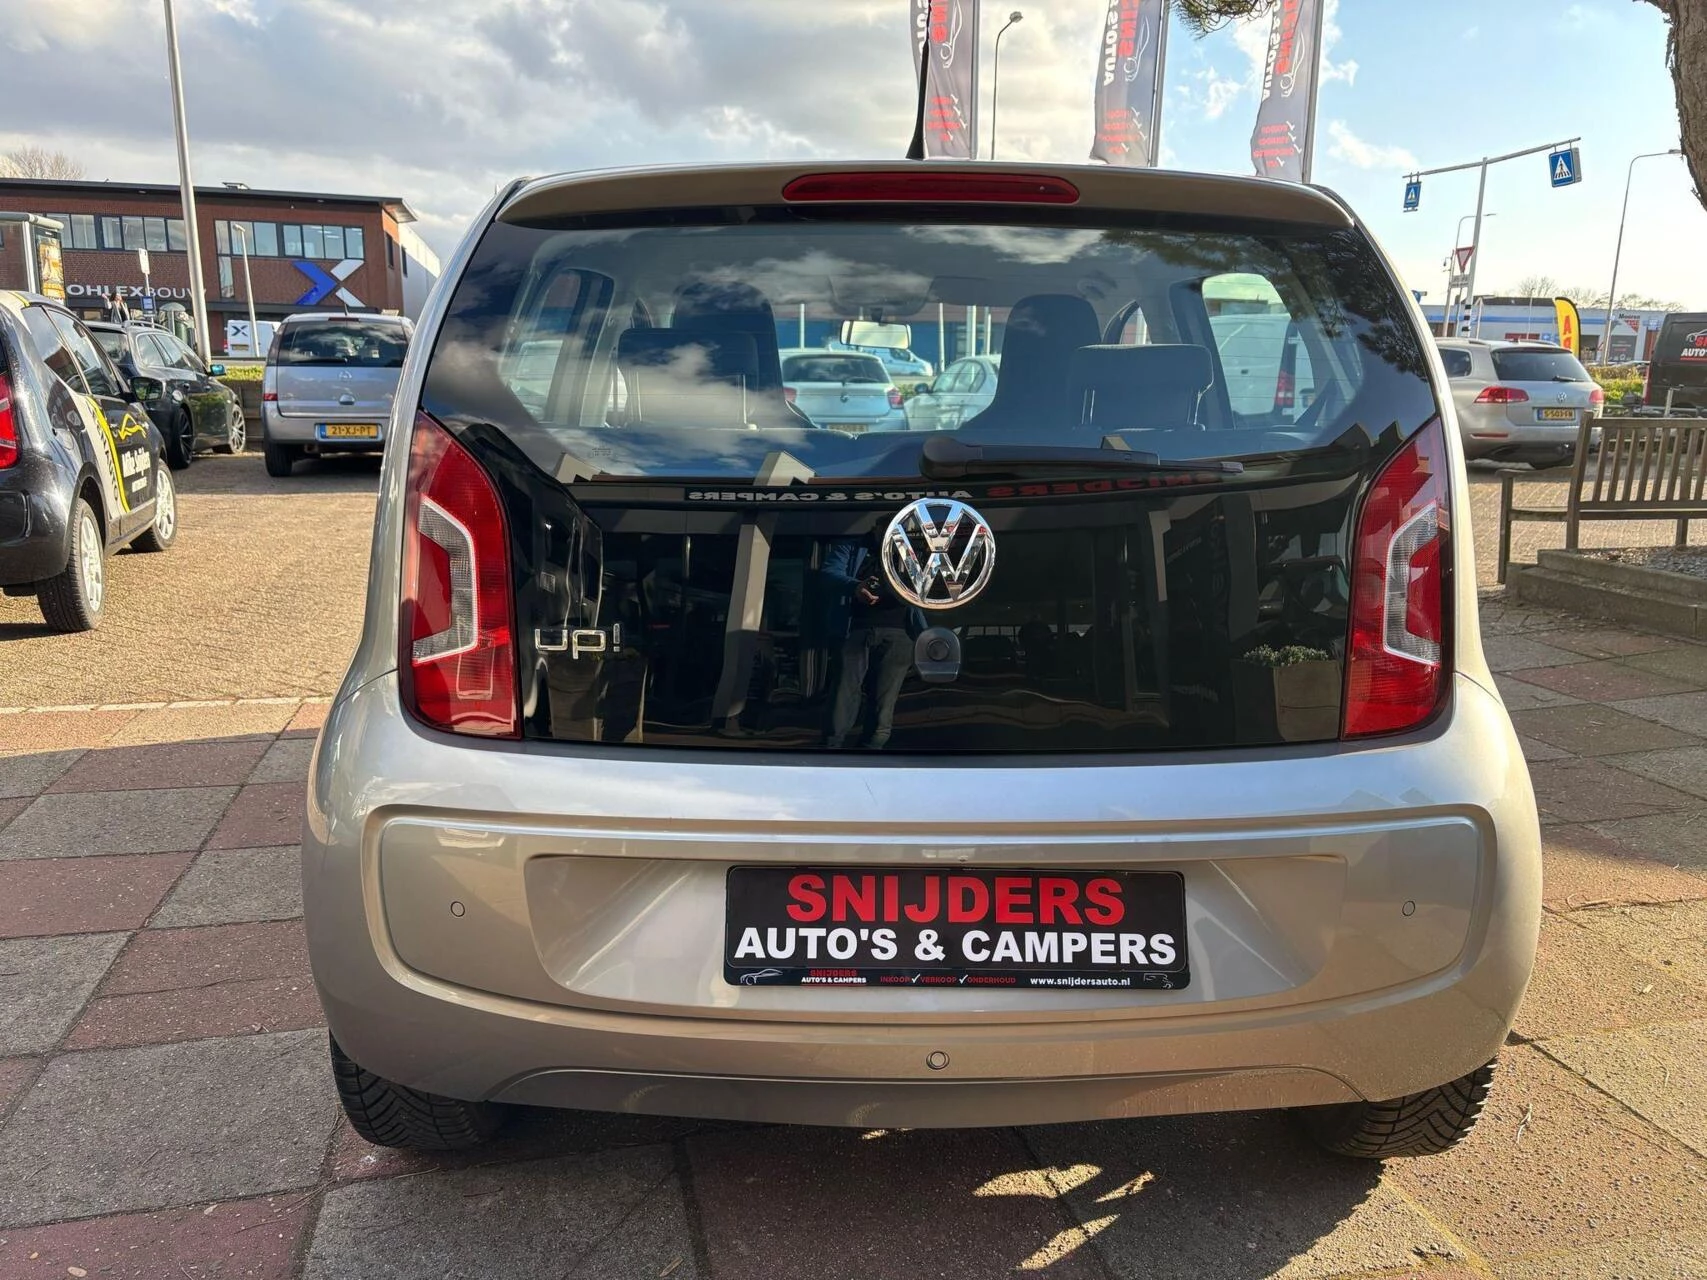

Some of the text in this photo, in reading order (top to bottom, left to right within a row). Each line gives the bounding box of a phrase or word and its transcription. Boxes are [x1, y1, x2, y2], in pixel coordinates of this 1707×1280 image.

[534, 623, 620, 660] up!
[786, 873, 1126, 926] SNIJDERS
[734, 927, 1176, 966] AUTO'S & CAMPERS
[920, 976, 957, 984] VERKOOP
[1030, 977, 1131, 987] www.snijdersauto.nl
